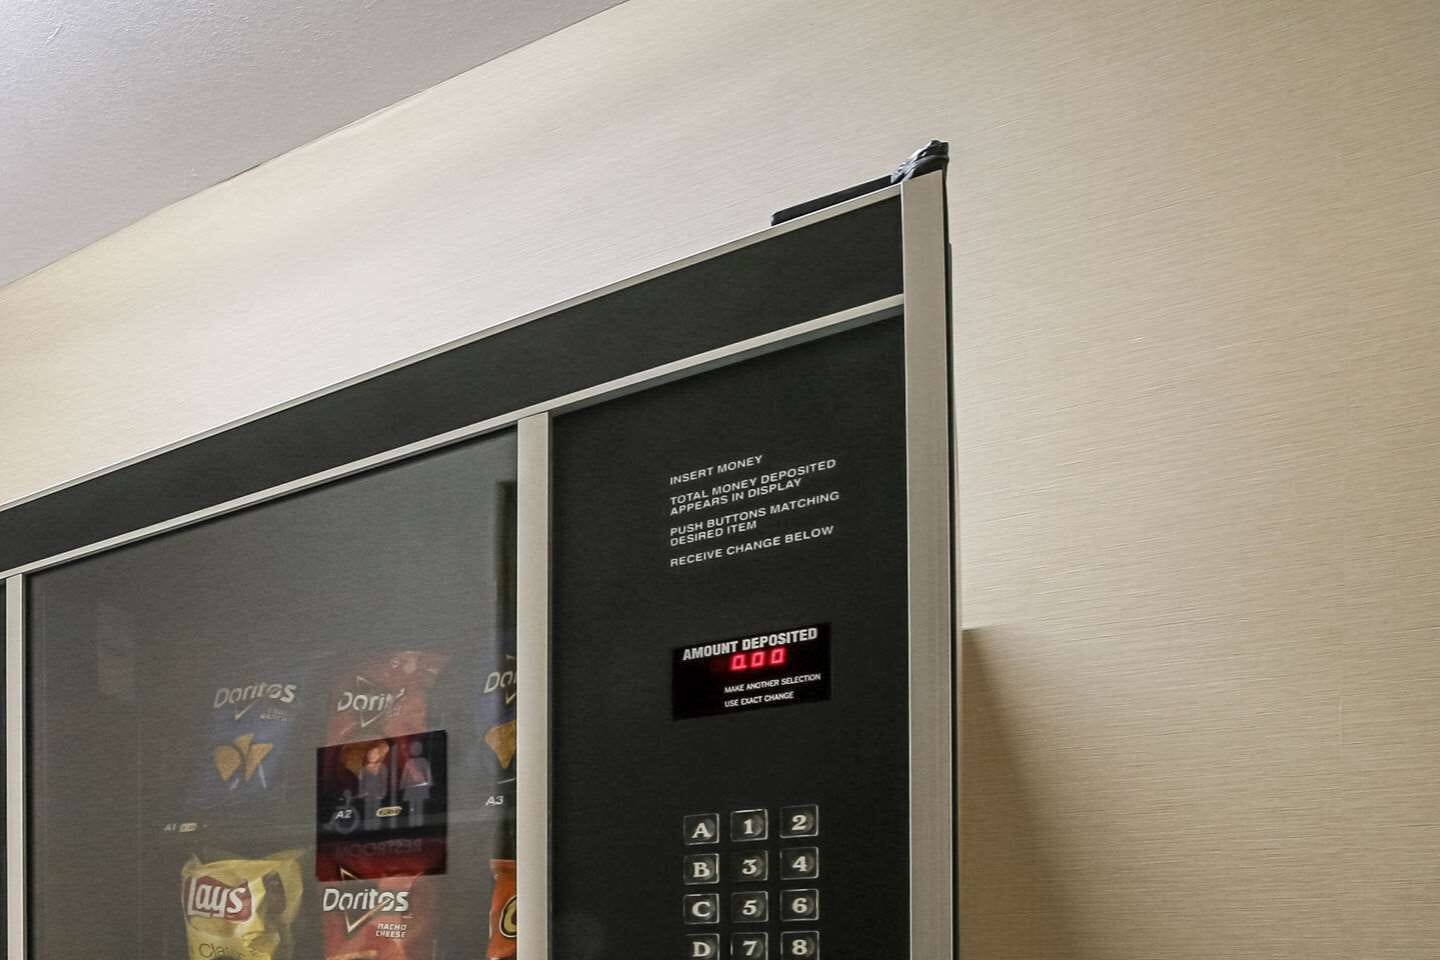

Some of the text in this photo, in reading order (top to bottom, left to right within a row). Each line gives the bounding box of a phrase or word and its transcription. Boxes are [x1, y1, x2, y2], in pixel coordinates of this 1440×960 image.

[670, 454, 763, 485] INSERT MONEY
[670, 458, 836, 506] TOTAL MONEY DEPOSITED
[670, 478, 802, 516] APPEARS IN DISPLAY
[670, 491, 840, 536] PUSH BUTTONS MATCHING
[670, 520, 757, 546] DESIRED ITEM
[670, 526, 834, 567] RECEIVE CHANGE BELOW
[682, 627, 818, 661] AMOUNT DEPOSITED
[724, 673, 821, 693] MAKE ANOTHER SELECTION
[214, 682, 297, 708] Doritos
[741, 696, 762, 705] EXACT
[764, 691, 794, 701] CHANGE
[485, 795, 504, 806] A3
[335, 809, 353, 819] A2
[692, 822, 711, 838] A
[744, 820, 753, 835] 1
[792, 815, 807, 831] 2
[693, 862, 710, 878] B
[742, 858, 757, 874] 3
[792, 855, 808, 872] 4
[323, 888, 409, 912] Doritos
[743, 900, 757, 915] 5
[792, 898, 808, 914] 6
[692, 901, 711, 918] C
[692, 942, 711, 957] D
[743, 941, 758, 956] 7
[792, 939, 808, 955] 8
